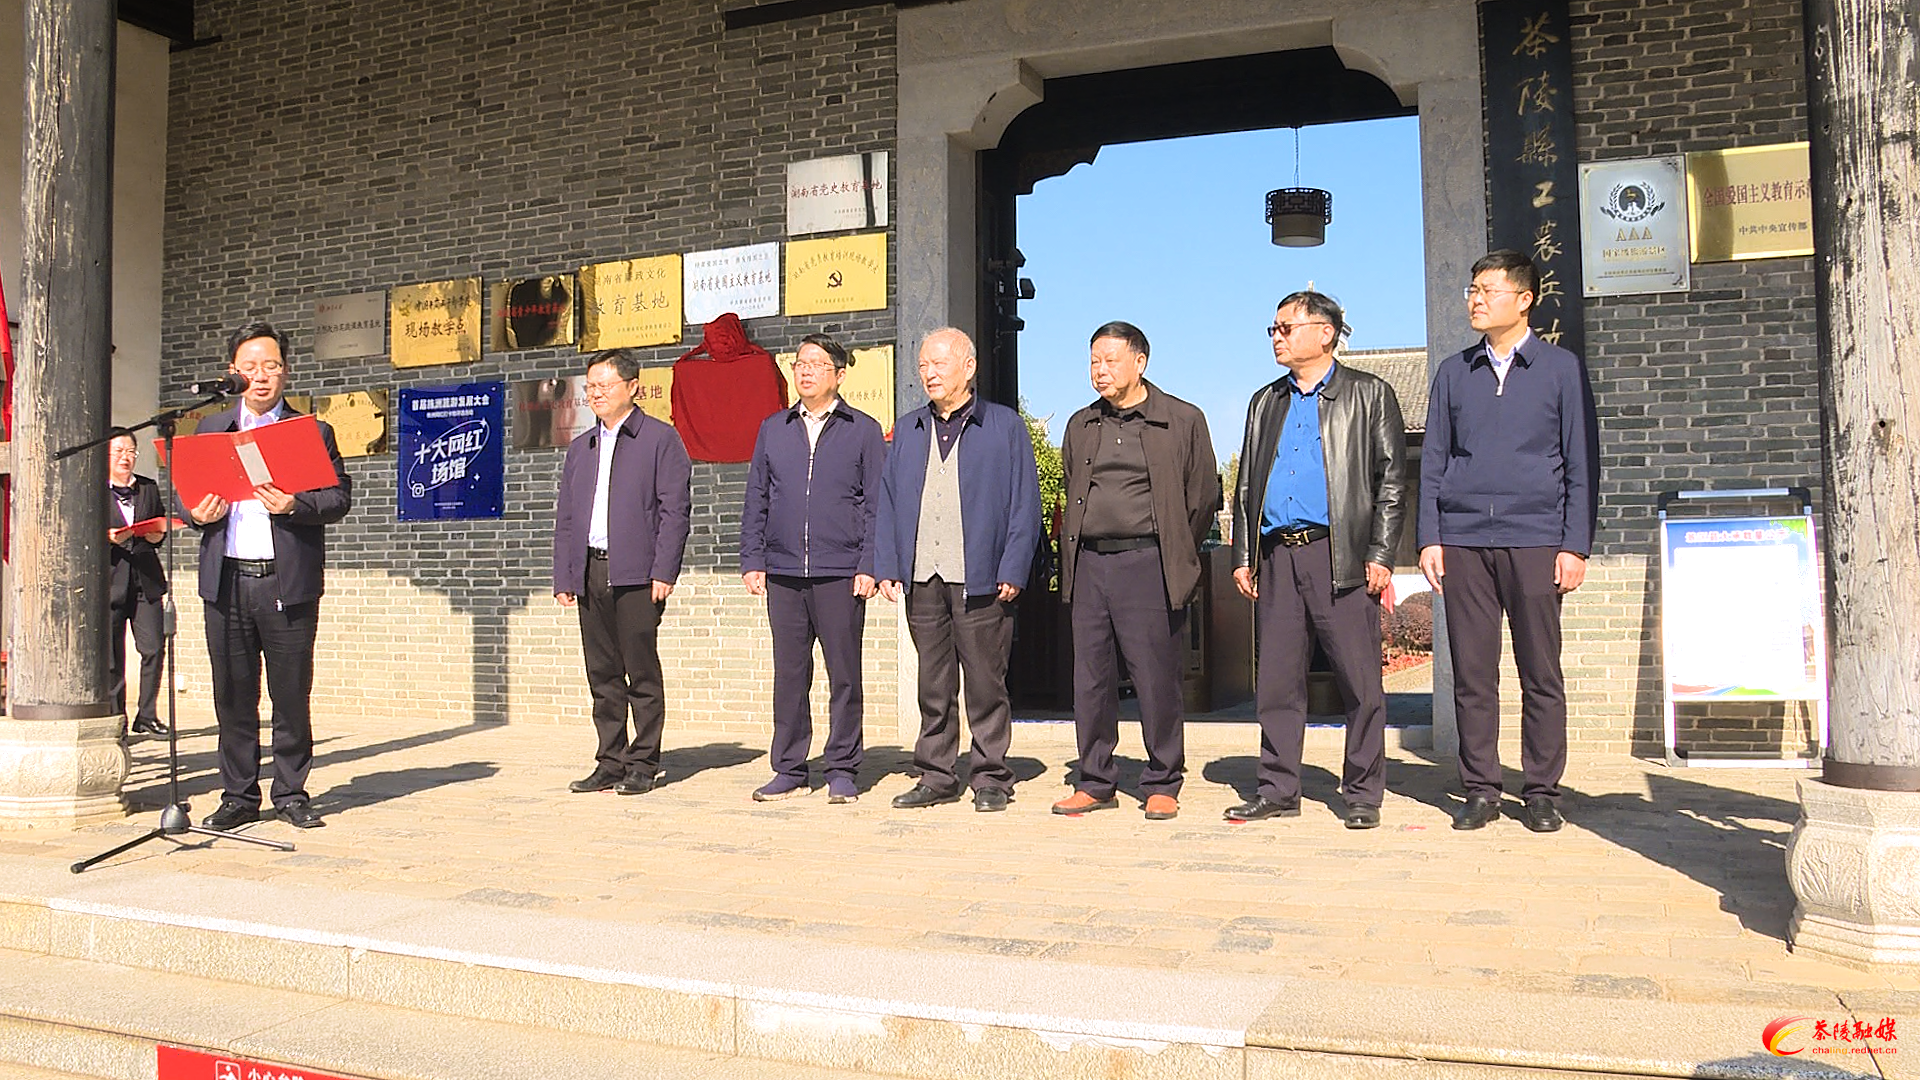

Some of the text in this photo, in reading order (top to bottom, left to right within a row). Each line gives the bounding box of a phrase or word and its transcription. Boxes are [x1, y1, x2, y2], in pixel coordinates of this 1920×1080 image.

[790, 178, 883, 198] 湖南省党史教育基地
[1615, 227, 1653, 241] AAA
[1738, 222, 1808, 236] 中共中央宣传部
[692, 269, 772, 291] 湖南省爱国主义教育基地
[404, 318, 467, 338] 现场教学点
[635, 385, 663, 401] 基地
[414, 428, 484, 465] 十大网红
[431, 457, 467, 485] 场馆
